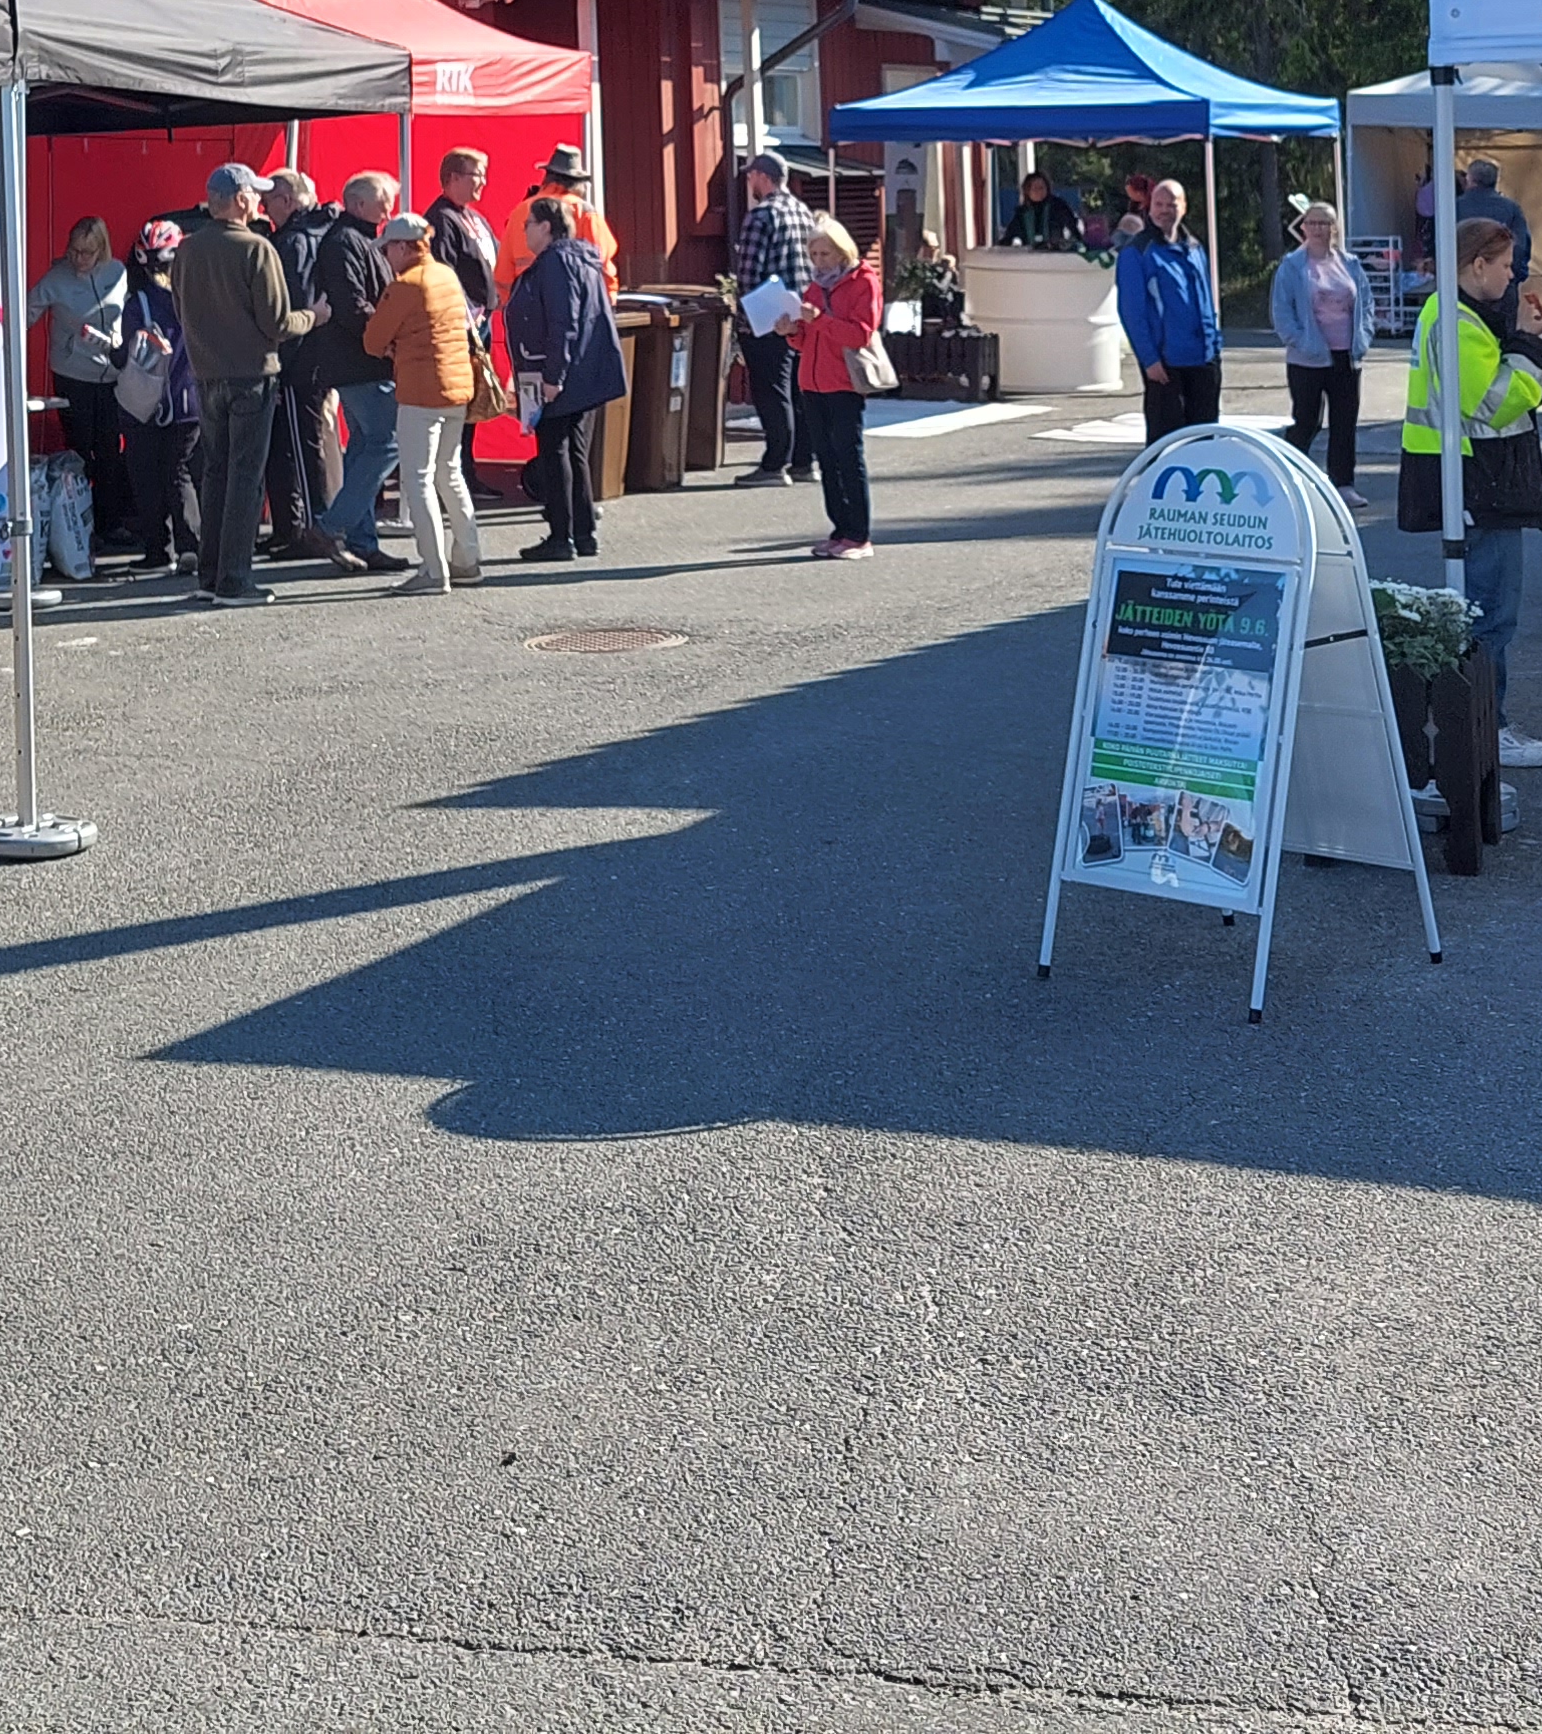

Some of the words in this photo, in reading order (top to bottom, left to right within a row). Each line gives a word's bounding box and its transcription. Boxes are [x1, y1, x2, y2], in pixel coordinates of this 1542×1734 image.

[1149, 507, 1208, 525] RAUMAN
[1212, 512, 1268, 530] SEUDUN
[1137, 523, 1274, 550] JÄTEHUOLTOLAITOS
[1115, 600, 1193, 627] JÄTTEIDEN
[1198, 608, 1235, 633] YÖTÄ
[1240, 617, 1269, 637] 9.6.
